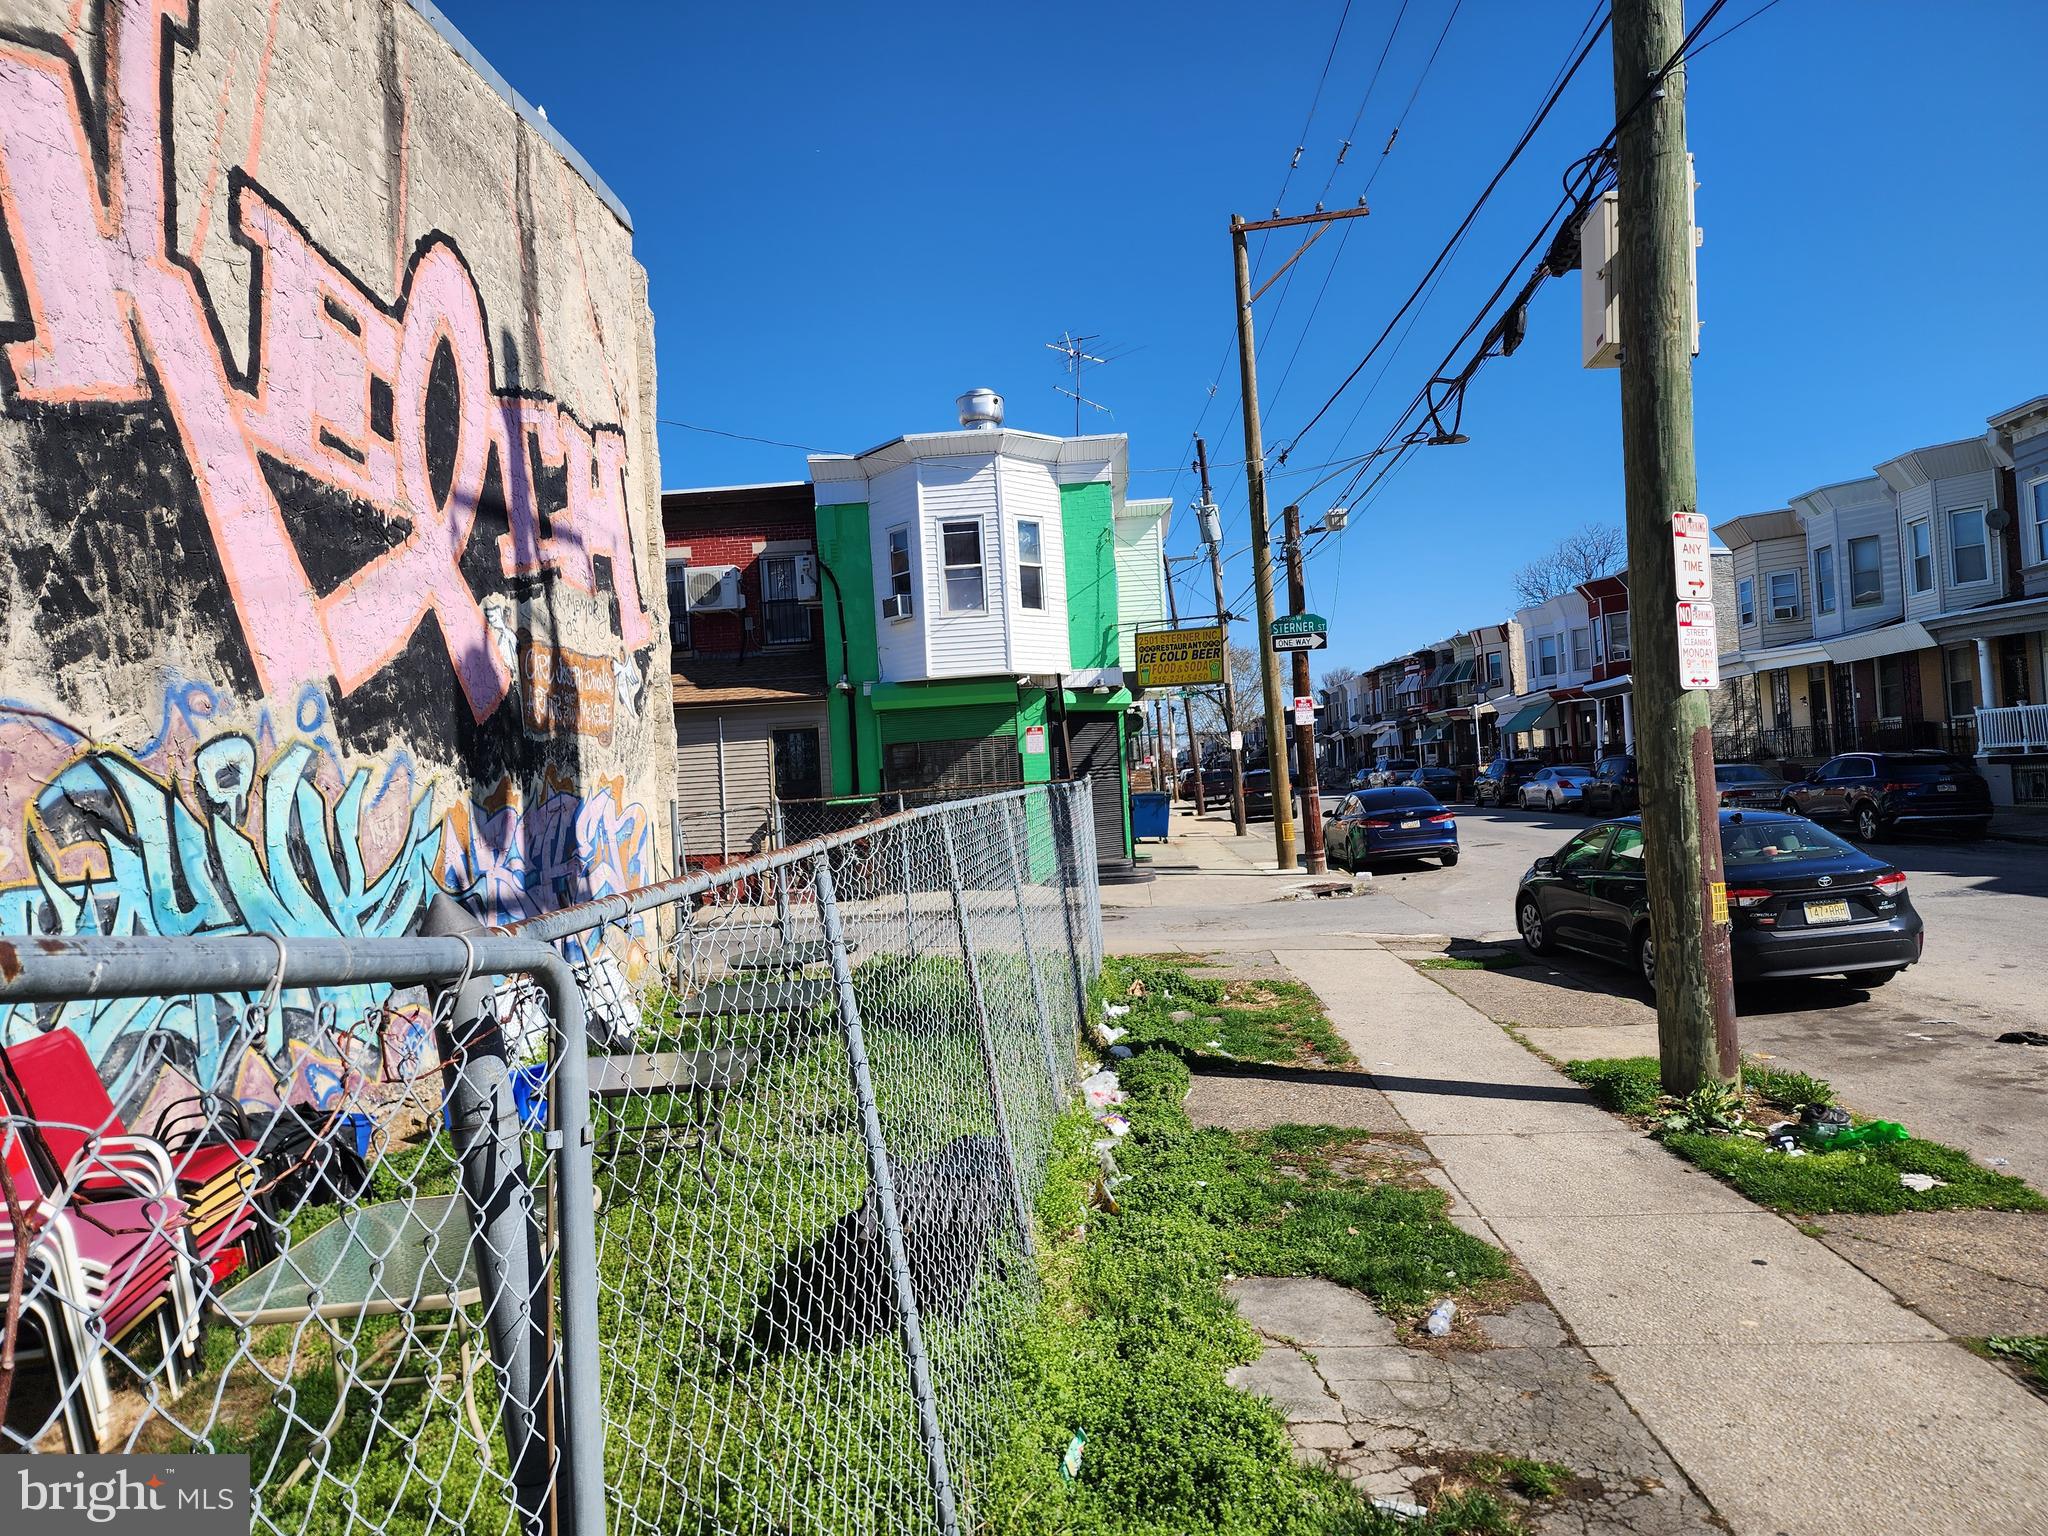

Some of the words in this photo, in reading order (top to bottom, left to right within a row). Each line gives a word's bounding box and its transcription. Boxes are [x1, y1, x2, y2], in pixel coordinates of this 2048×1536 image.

[1675, 516, 1685, 533] NO
[1683, 543, 1701, 554] ANY
[1683, 560, 1703, 571] TIME
[1679, 606, 1691, 623] NO
[1272, 621, 1314, 634] STERNER
[1317, 623, 1325, 631] ST
[1139, 635, 1158, 646] 2501
[1160, 632, 1200, 643] STERNER
[1202, 630, 1220, 640] INC.
[1295, 638, 1310, 646] WAY
[1684, 638, 1712, 647] CLEANING
[1156, 641, 1202, 652] RESTAURANT
[1140, 652, 1157, 664] ICE
[1160, 650, 1188, 662] COLD
[1192, 647, 1220, 660] BEER
[1683, 648, 1713, 658] MONDAY
[1152, 663, 1176, 675] FOOD
[1184, 661, 1209, 673] SODA
